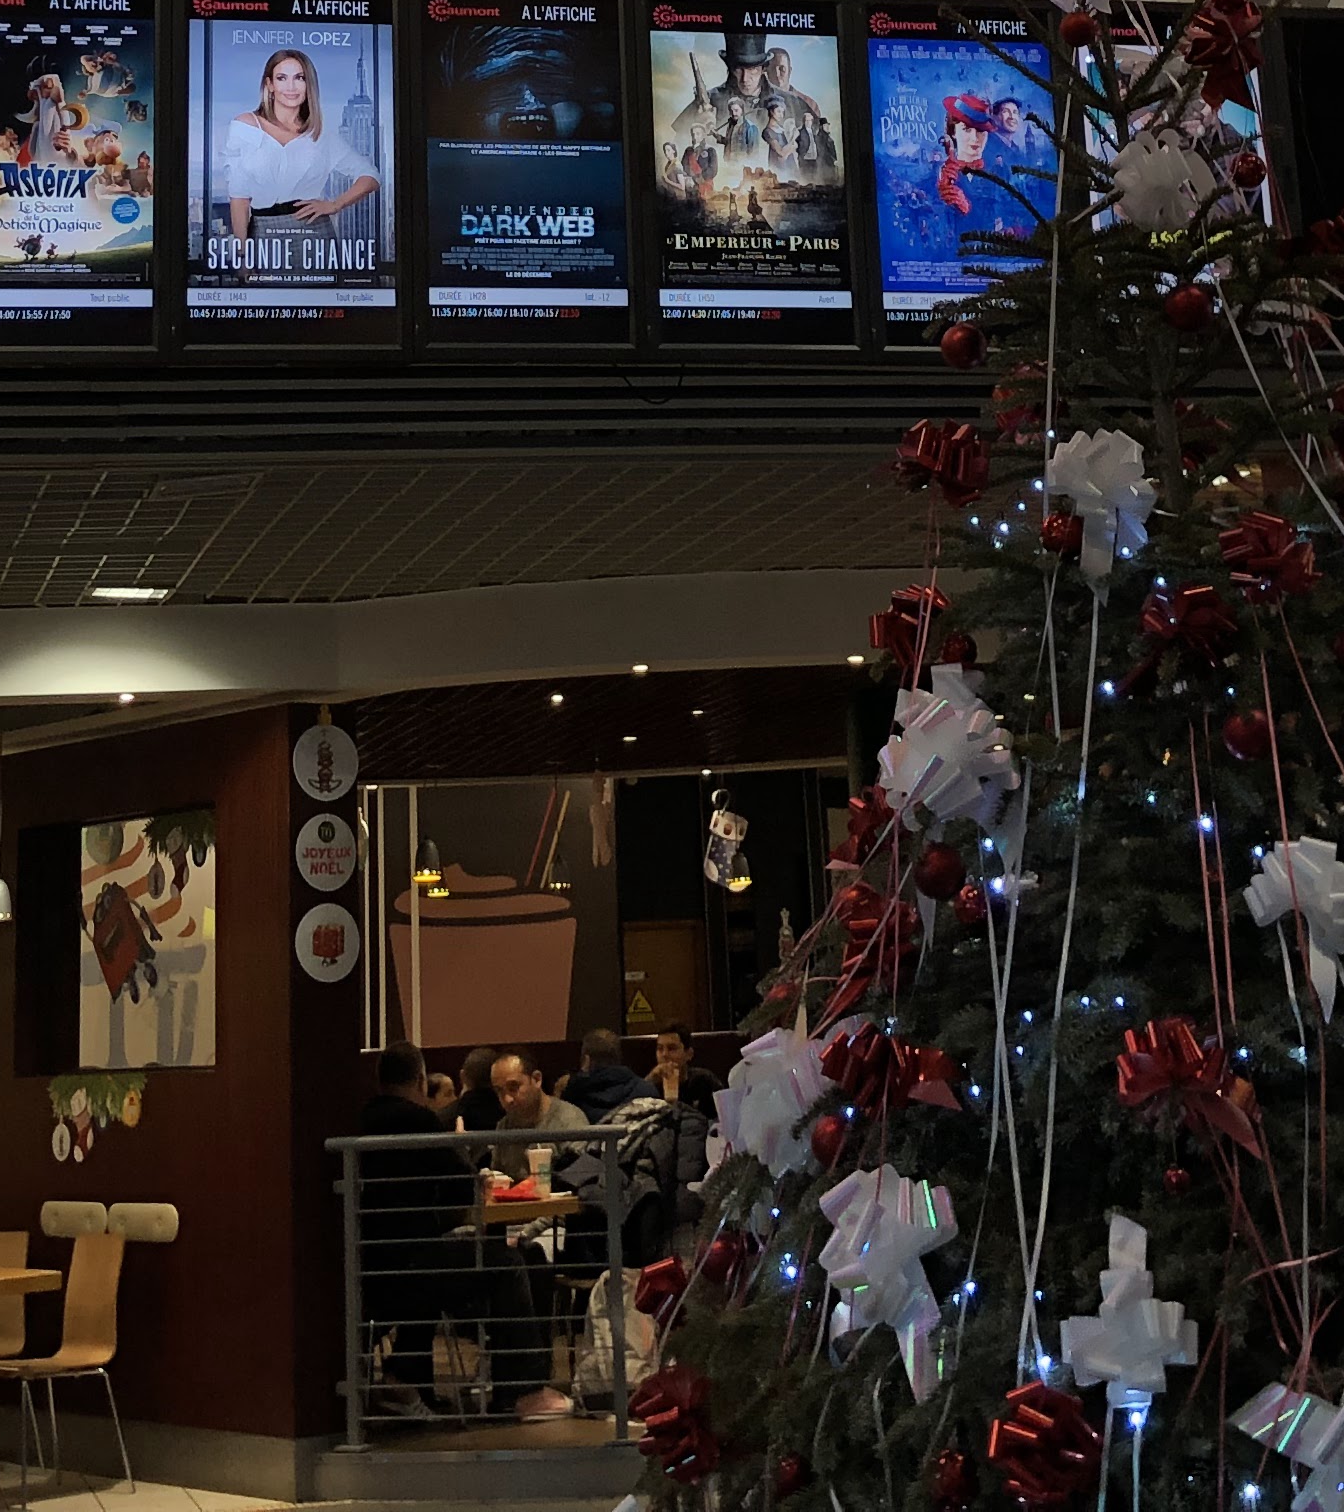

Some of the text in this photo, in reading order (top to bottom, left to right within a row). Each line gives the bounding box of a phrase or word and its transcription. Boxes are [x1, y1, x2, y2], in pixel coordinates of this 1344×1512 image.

[201, 0, 269, 12] Gaumont
[291, 0, 370, 17] A L'AFFICHE
[435, 5, 501, 17] Gaumont
[521, 5, 597, 22] A L'AFFICHE
[659, 11, 723, 24] Gaumont
[743, 11, 816, 29] A L'AFFICHE
[876, 19, 938, 31] Gaumont
[231, 29, 352, 47] JENNIFER LOPEZ
[890, 104, 928, 123] MARY
[879, 115, 939, 144] POPPINS
[17, 200, 75, 215] Le Secret
[460, 204, 595, 216] UNFRIENDED
[39, 217, 103, 233] Magique
[460, 214, 595, 237] DARK WEB
[788, 235, 841, 252] PARIS
[207, 237, 376, 271] SECONDE CHANCE
[302, 847, 353, 859] JOYEUX
